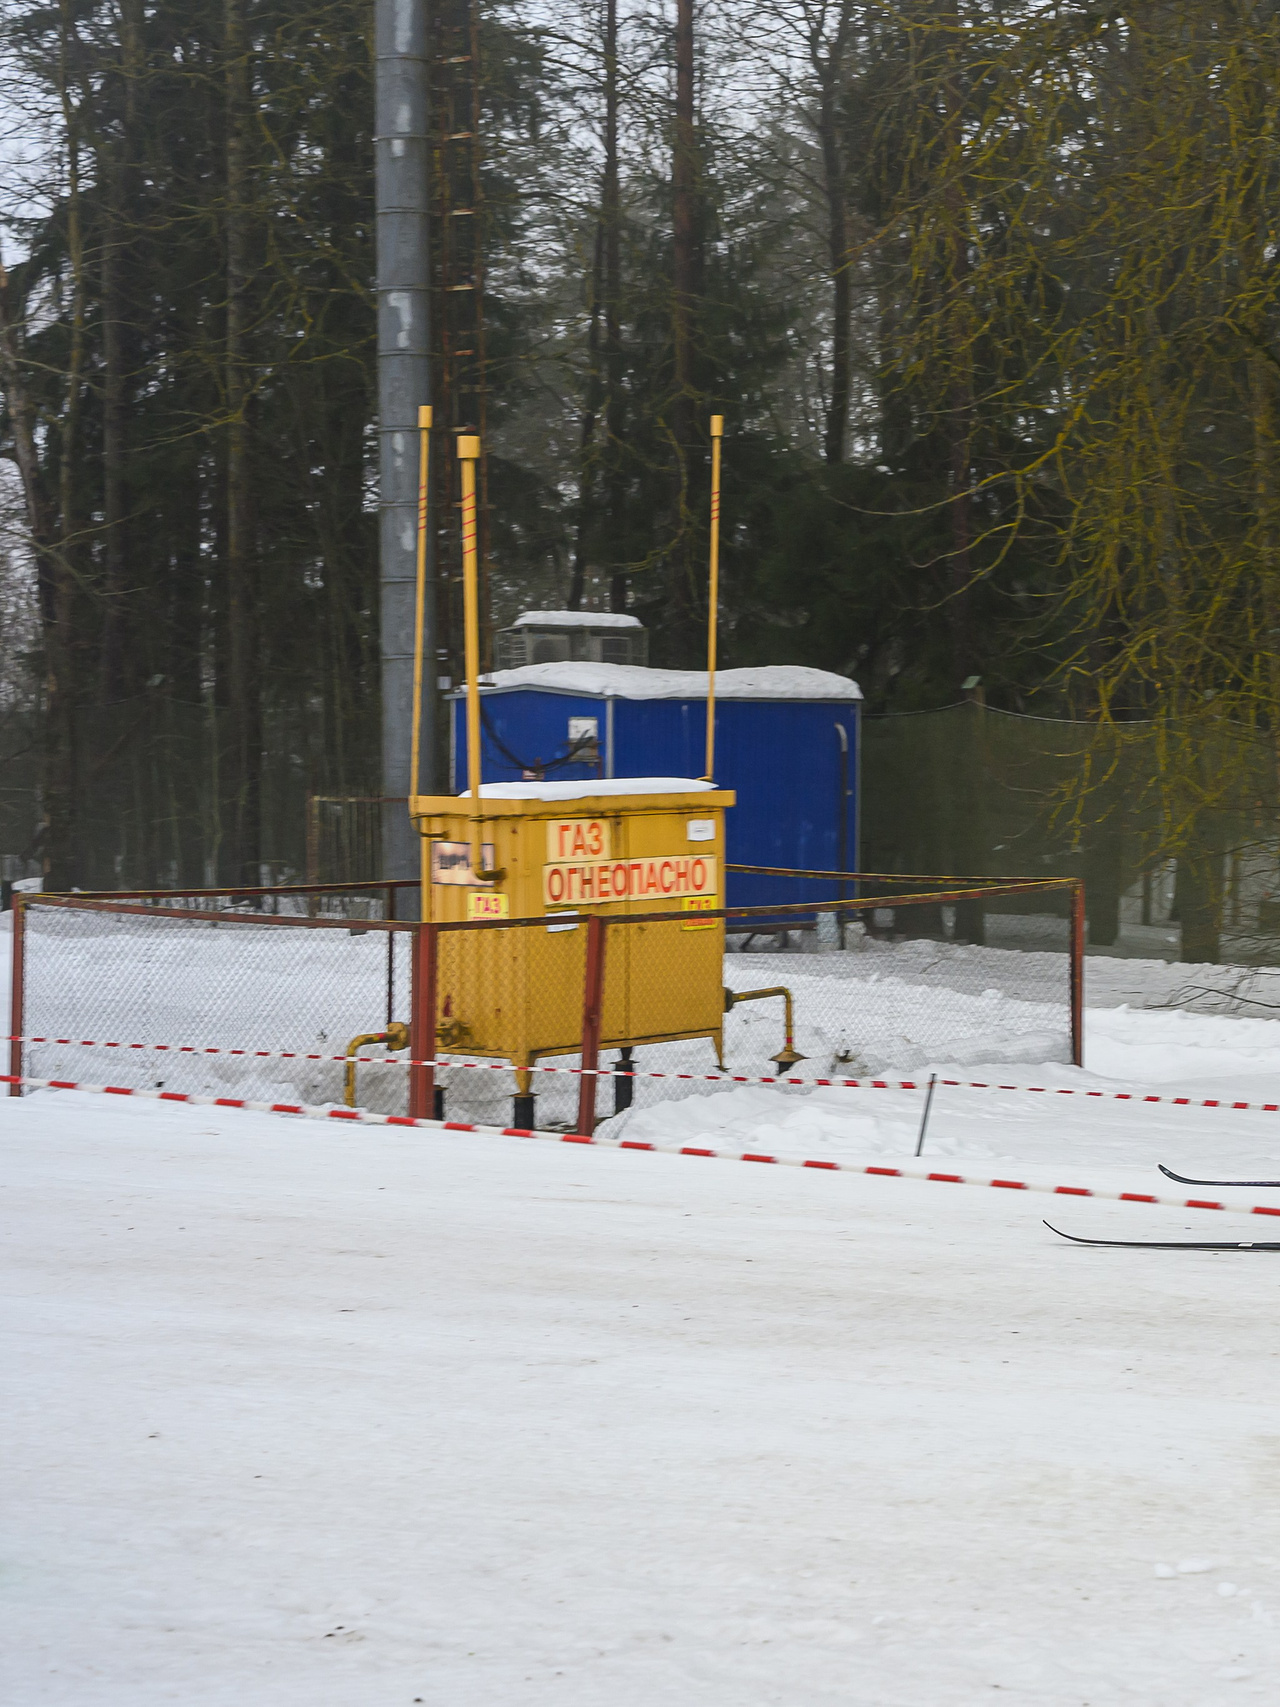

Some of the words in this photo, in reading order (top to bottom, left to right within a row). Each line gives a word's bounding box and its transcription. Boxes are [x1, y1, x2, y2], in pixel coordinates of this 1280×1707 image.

[559, 822, 604, 857] ГАЗ
[548, 859, 706, 901] ОГНЕОПАСНО
[474, 896, 501, 914] ГАЗ
